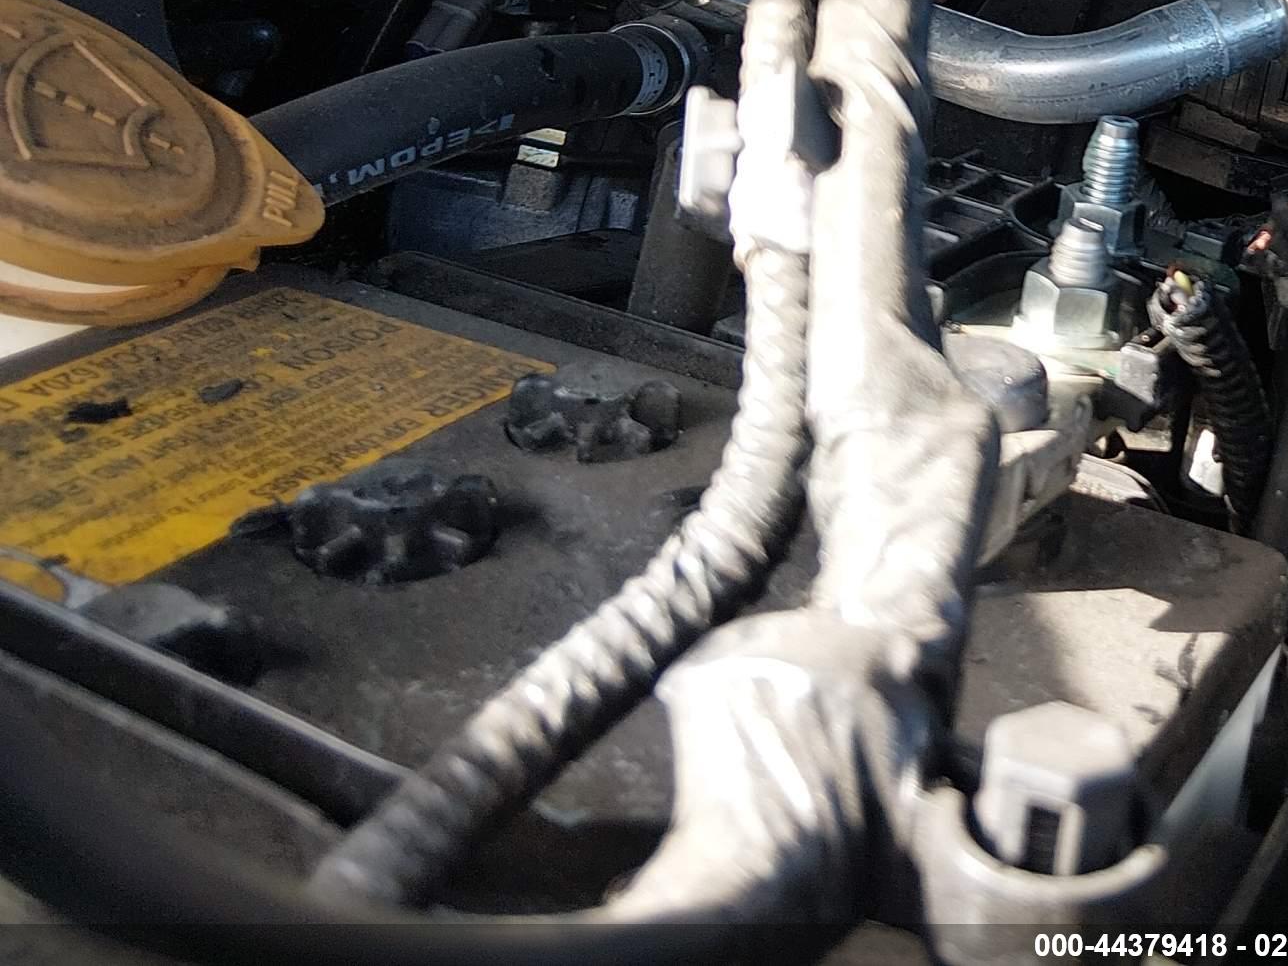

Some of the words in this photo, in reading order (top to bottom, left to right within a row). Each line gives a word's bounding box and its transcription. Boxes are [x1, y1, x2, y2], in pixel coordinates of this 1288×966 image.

[262, 170, 299, 227] PULL
[274, 319, 403, 371] POISON
[14, 365, 103, 400] 620A
[413, 359, 538, 418] DANGER
[110, 402, 204, 441] SEVERE
[310, 415, 425, 469] EXPLOSIVE
[246, 462, 328, 501] GASES
